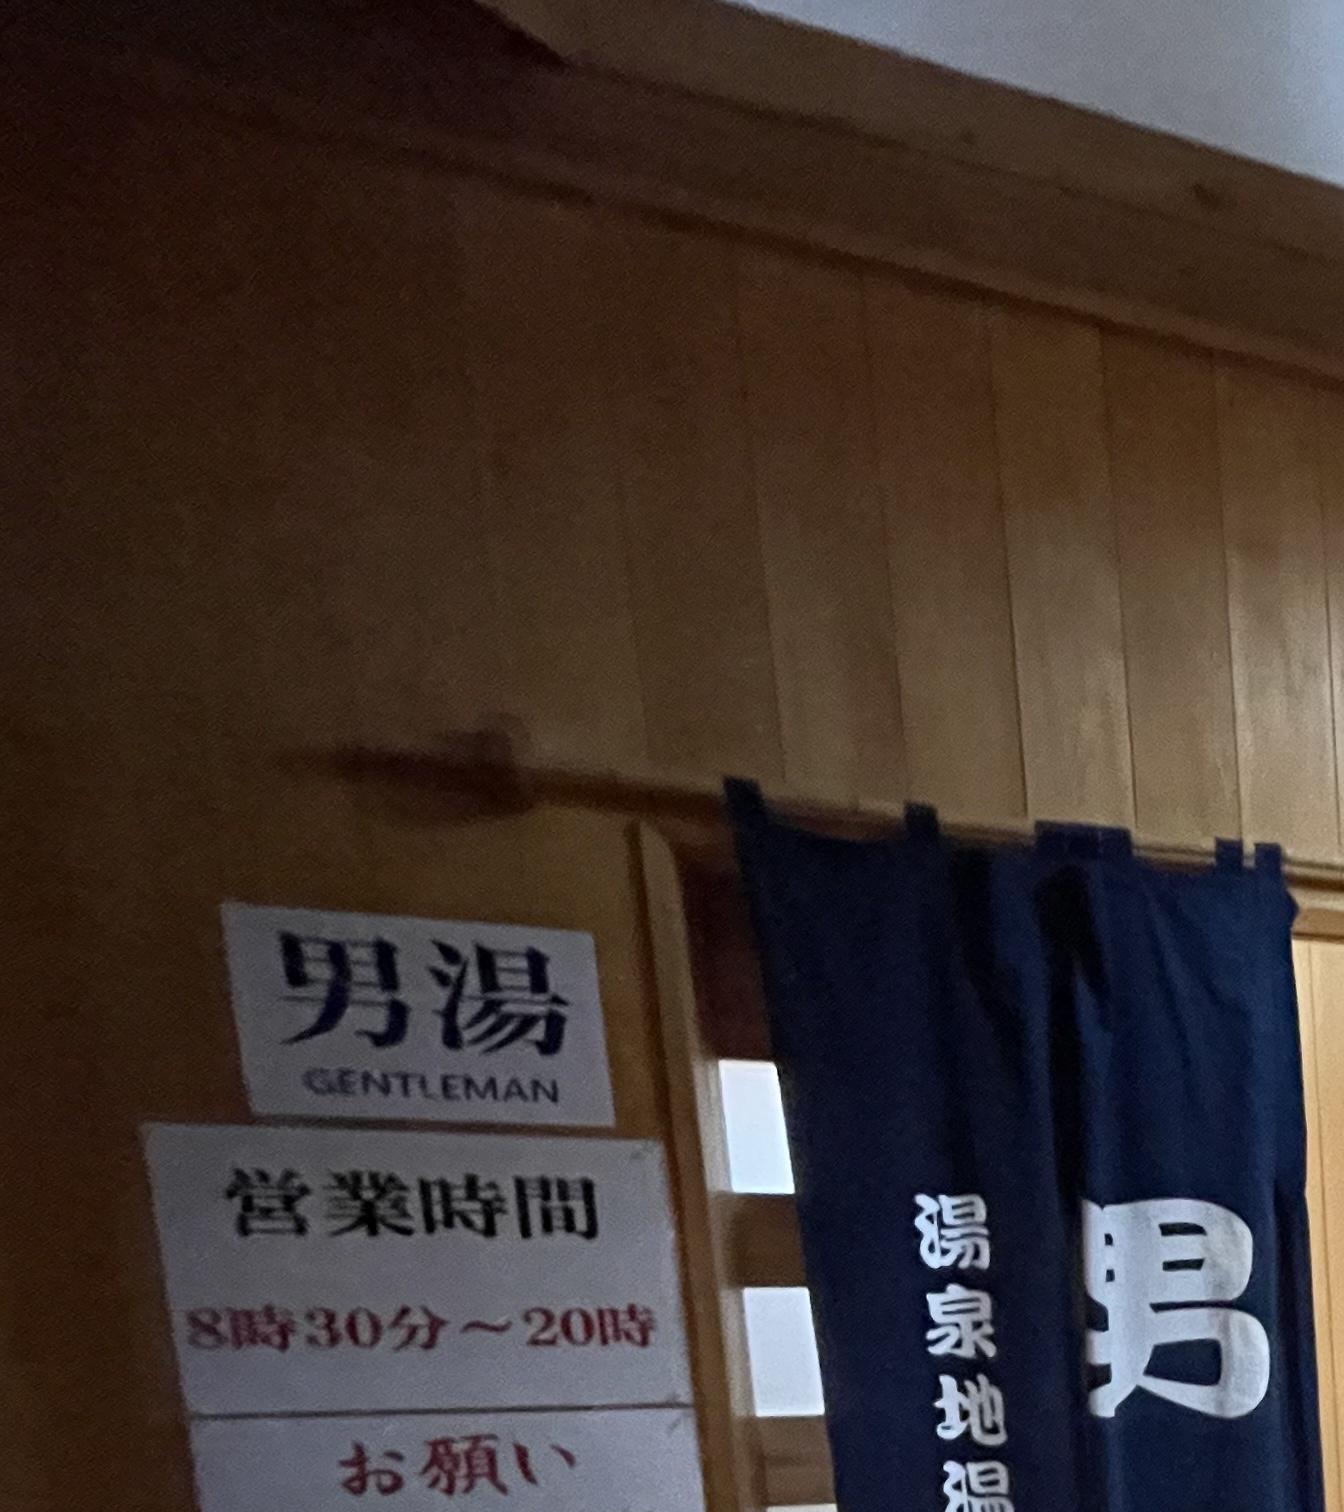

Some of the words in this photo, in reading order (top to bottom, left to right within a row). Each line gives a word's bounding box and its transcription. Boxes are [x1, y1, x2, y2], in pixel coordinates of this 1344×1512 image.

[277, 931, 570, 1057] 男湯
[304, 1067, 561, 1105] GENTLEMAN
[225, 1166, 599, 1239] 営業時間
[339, 1434, 577, 1496] お願い
